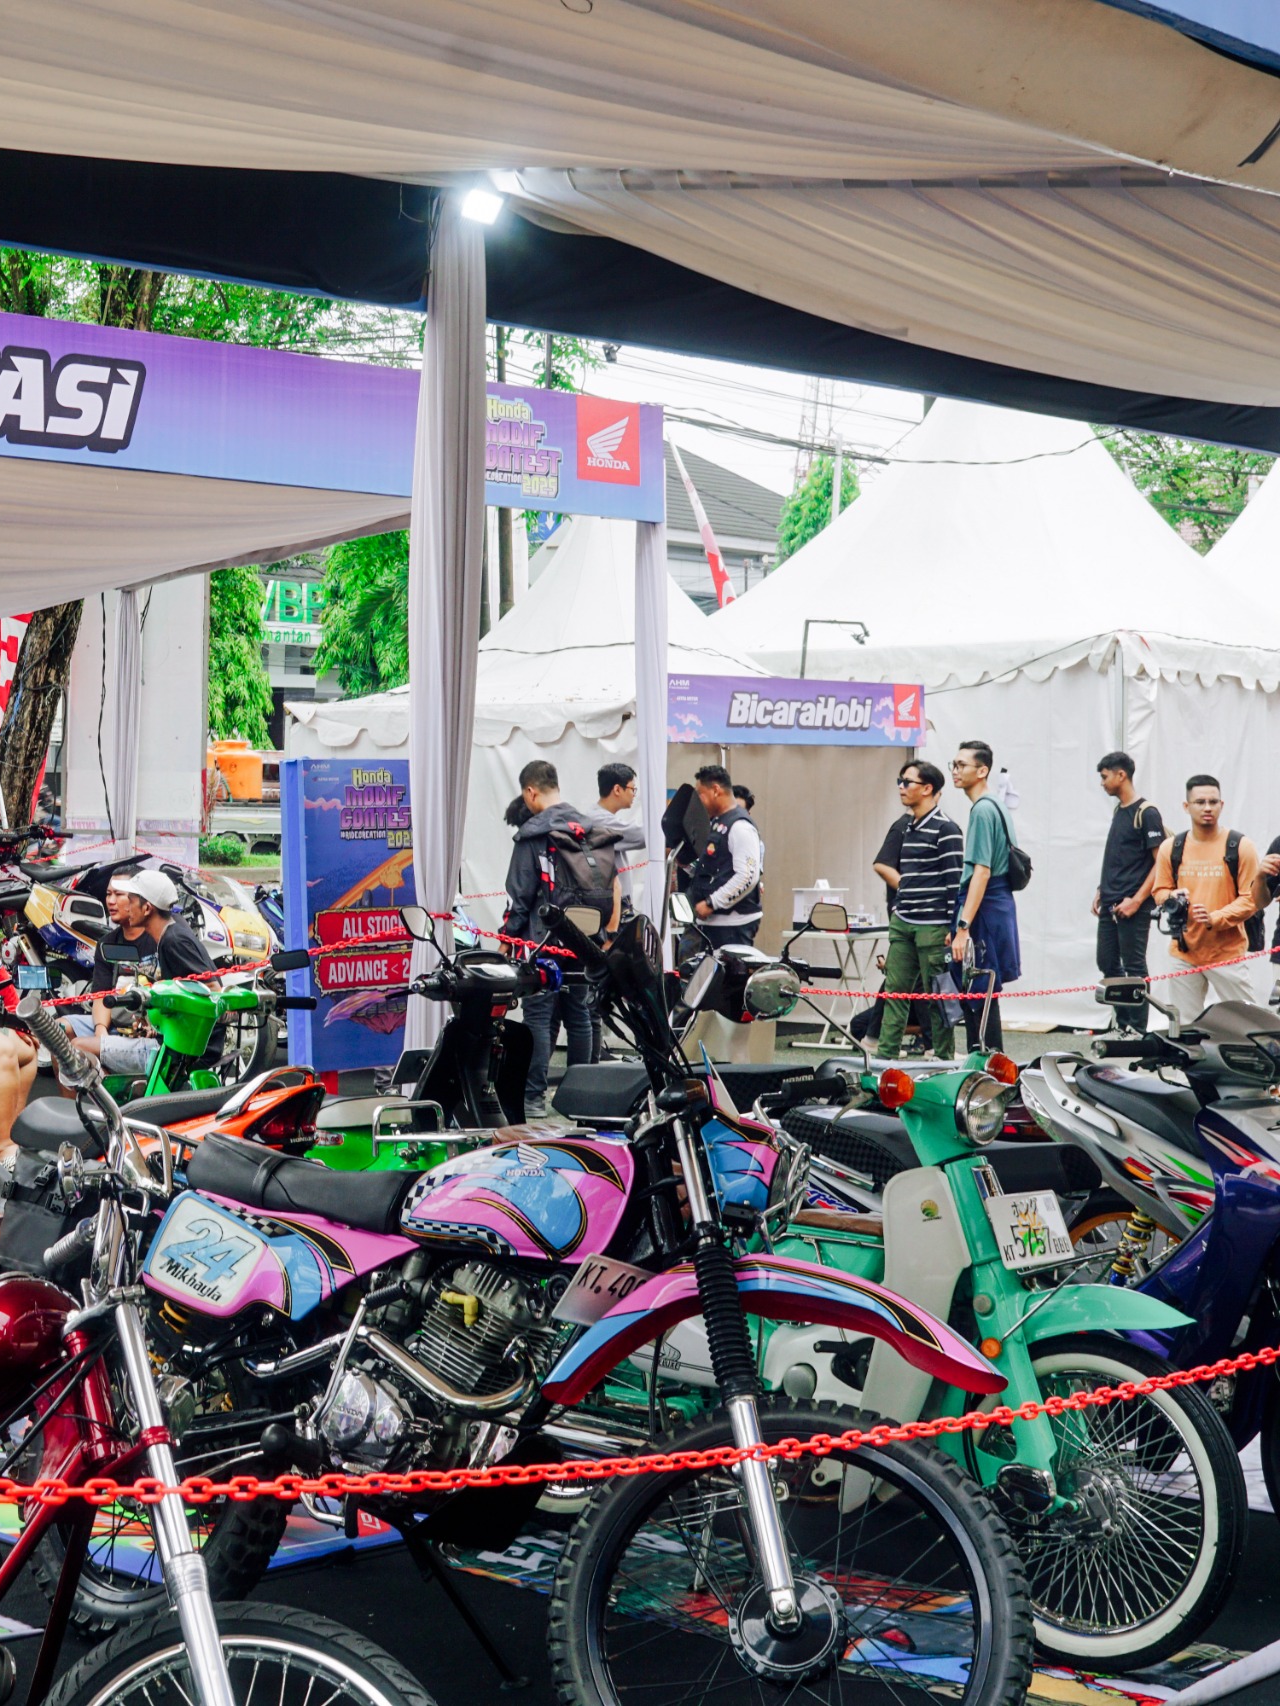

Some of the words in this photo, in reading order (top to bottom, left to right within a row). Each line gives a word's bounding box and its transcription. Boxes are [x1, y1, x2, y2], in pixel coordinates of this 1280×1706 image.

[487, 398, 530, 420] Honda
[486, 444, 561, 476] ONTEST
[586, 456, 631, 471] HONDA
[521, 475, 558, 497] 2025
[729, 692, 873, 729] BicaraHobi
[352, 768, 391, 787] Honda
[345, 785, 405, 808] MODIF
[340, 806, 412, 831] CONTES
[343, 917, 365, 938] ALL
[328, 959, 388, 984] ADVANCE
[506, 1167, 546, 1178] HONDA
[159, 1218, 257, 1284] 24
[1009, 1223, 1053, 1258] 5757
[1003, 1244, 1016, 1262] KT
[158, 1258, 223, 1303] Mikhayla
